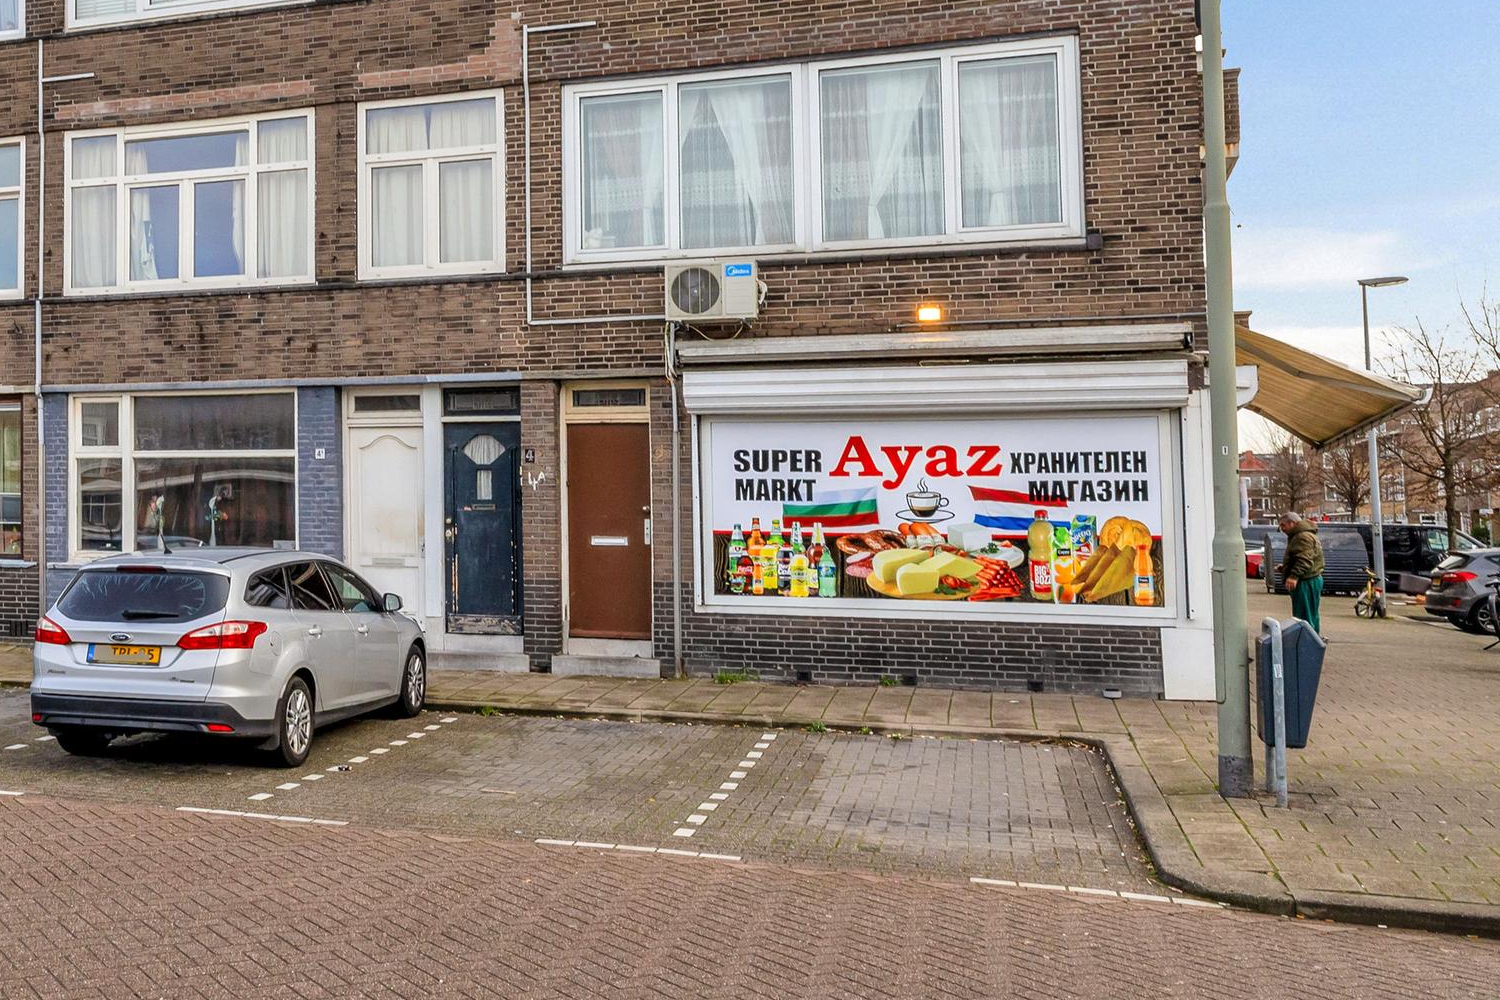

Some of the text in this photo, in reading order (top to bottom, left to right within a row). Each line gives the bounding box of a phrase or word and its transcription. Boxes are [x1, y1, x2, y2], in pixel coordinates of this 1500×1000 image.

[525, 449, 534, 462] 4
[733, 449, 822, 473] SUPER
[828, 435, 1003, 490] Ayaz
[1009, 450, 1148, 474] ХРАНИТЕЛЕН
[735, 478, 817, 502] MARKT
[1028, 479, 1149, 502] МАГАЗИН
